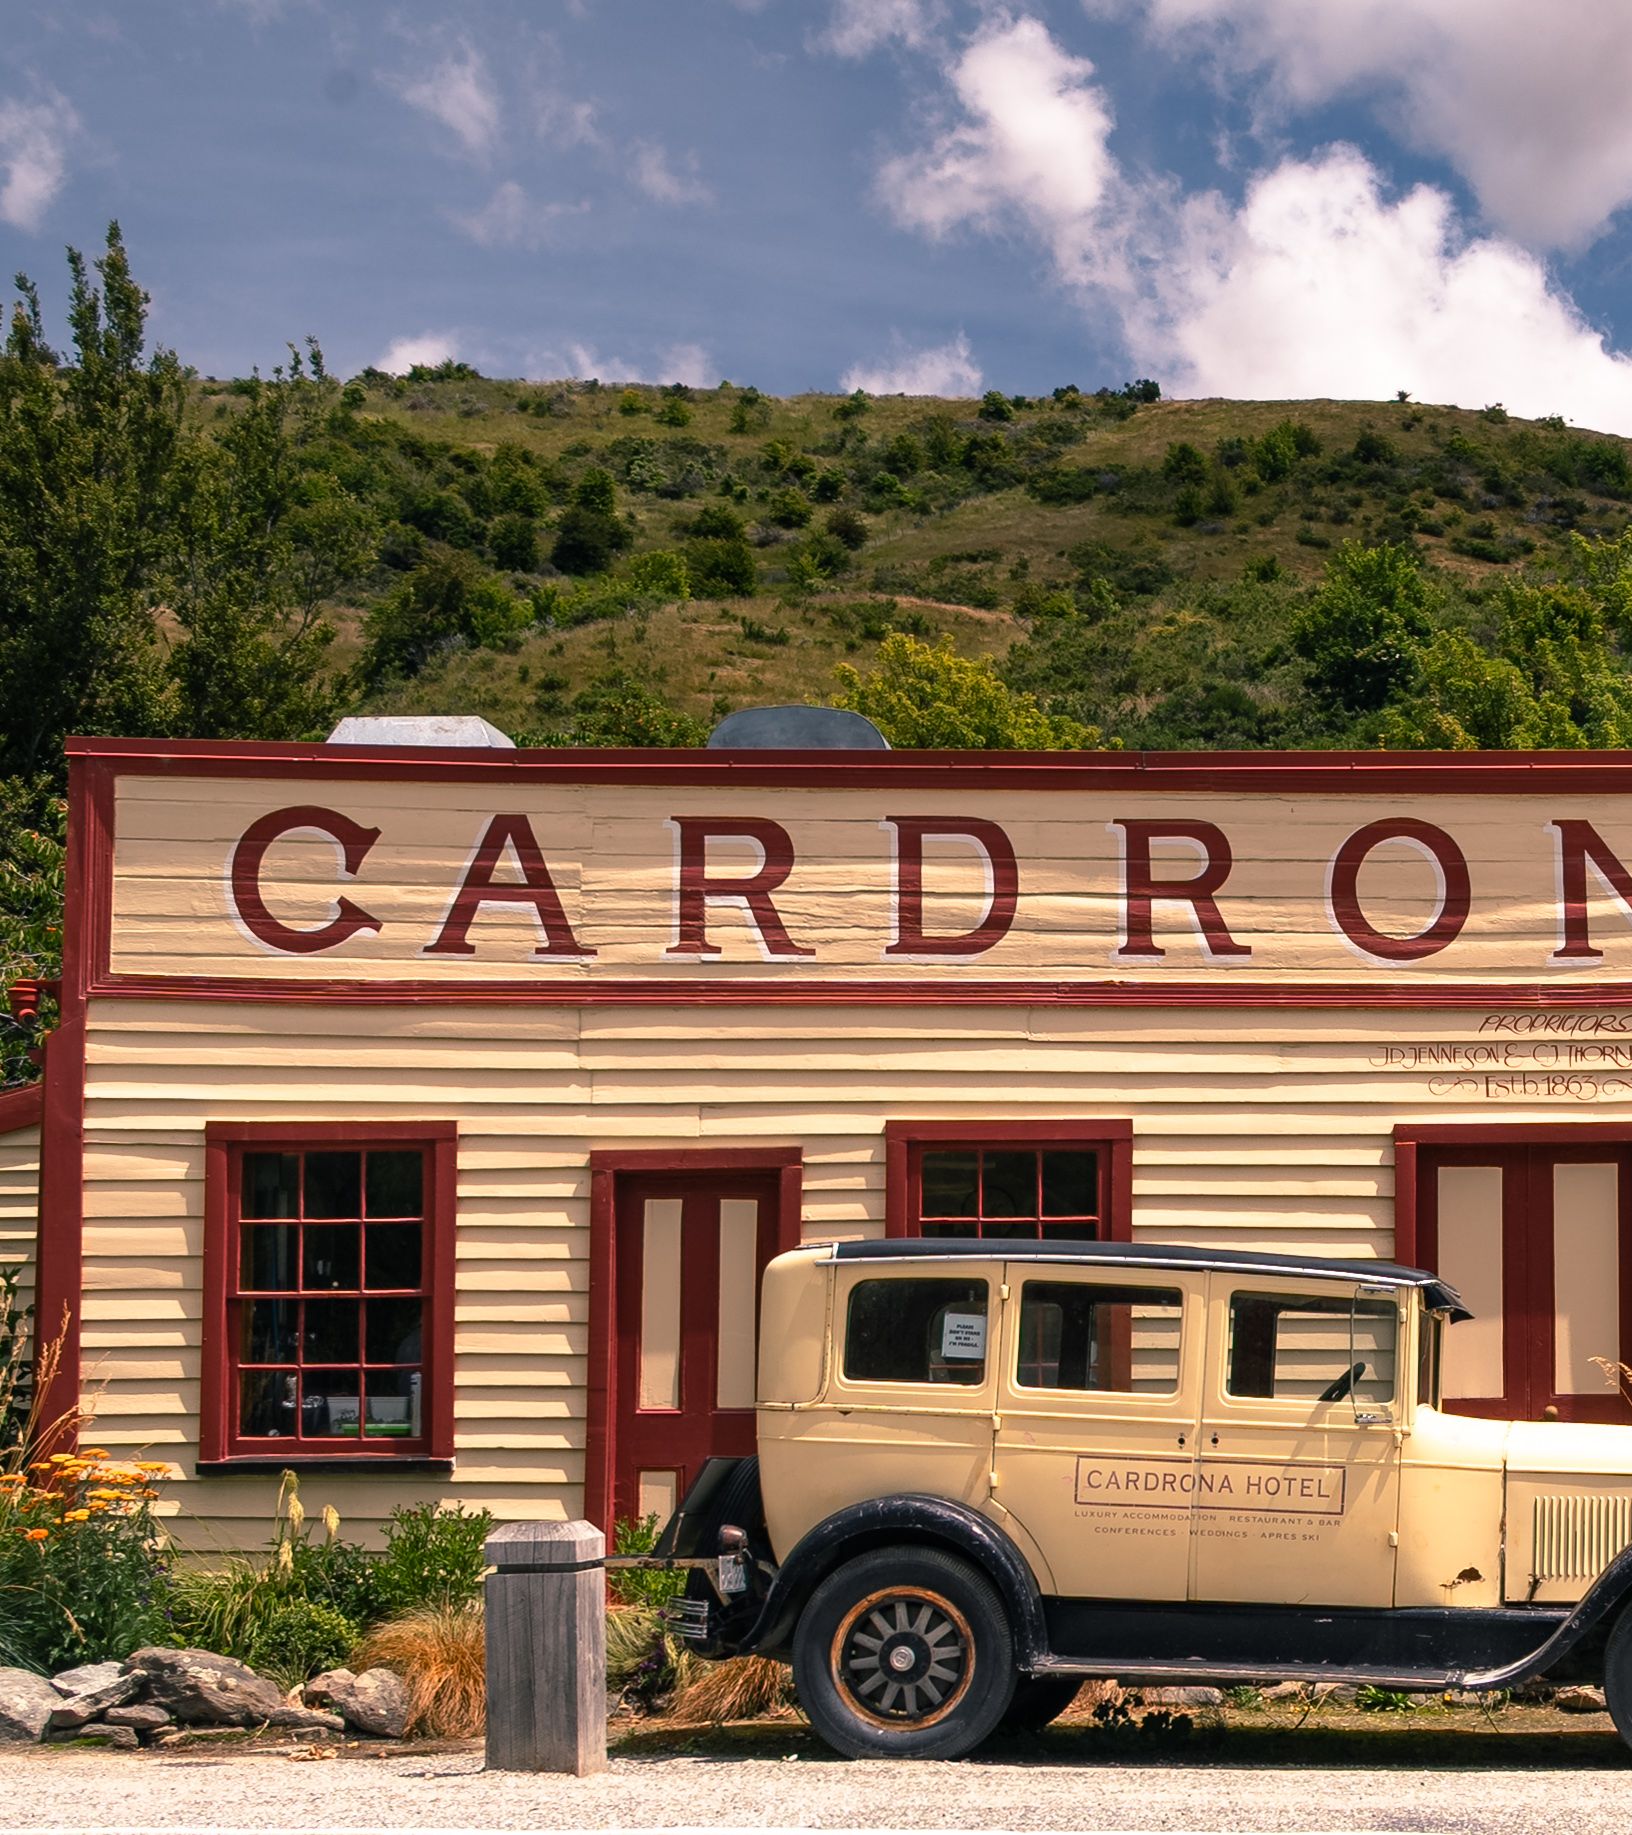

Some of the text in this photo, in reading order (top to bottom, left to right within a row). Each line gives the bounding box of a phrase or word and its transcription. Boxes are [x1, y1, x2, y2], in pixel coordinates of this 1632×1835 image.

[1087, 1470, 1330, 1498] CARDRONA HOTEL
[1074, 1510, 1118, 1518] LUXURY
[1123, 1512, 1217, 1522] ACCOMMODATION
[1229, 1515, 1303, 1525] RESTAURANT
[1318, 1519, 1341, 1527] BAR
[1094, 1526, 1177, 1537] CONFERENCES
[1189, 1529, 1248, 1538] WEDDINGS
[1260, 1532, 1297, 1541] APRES
